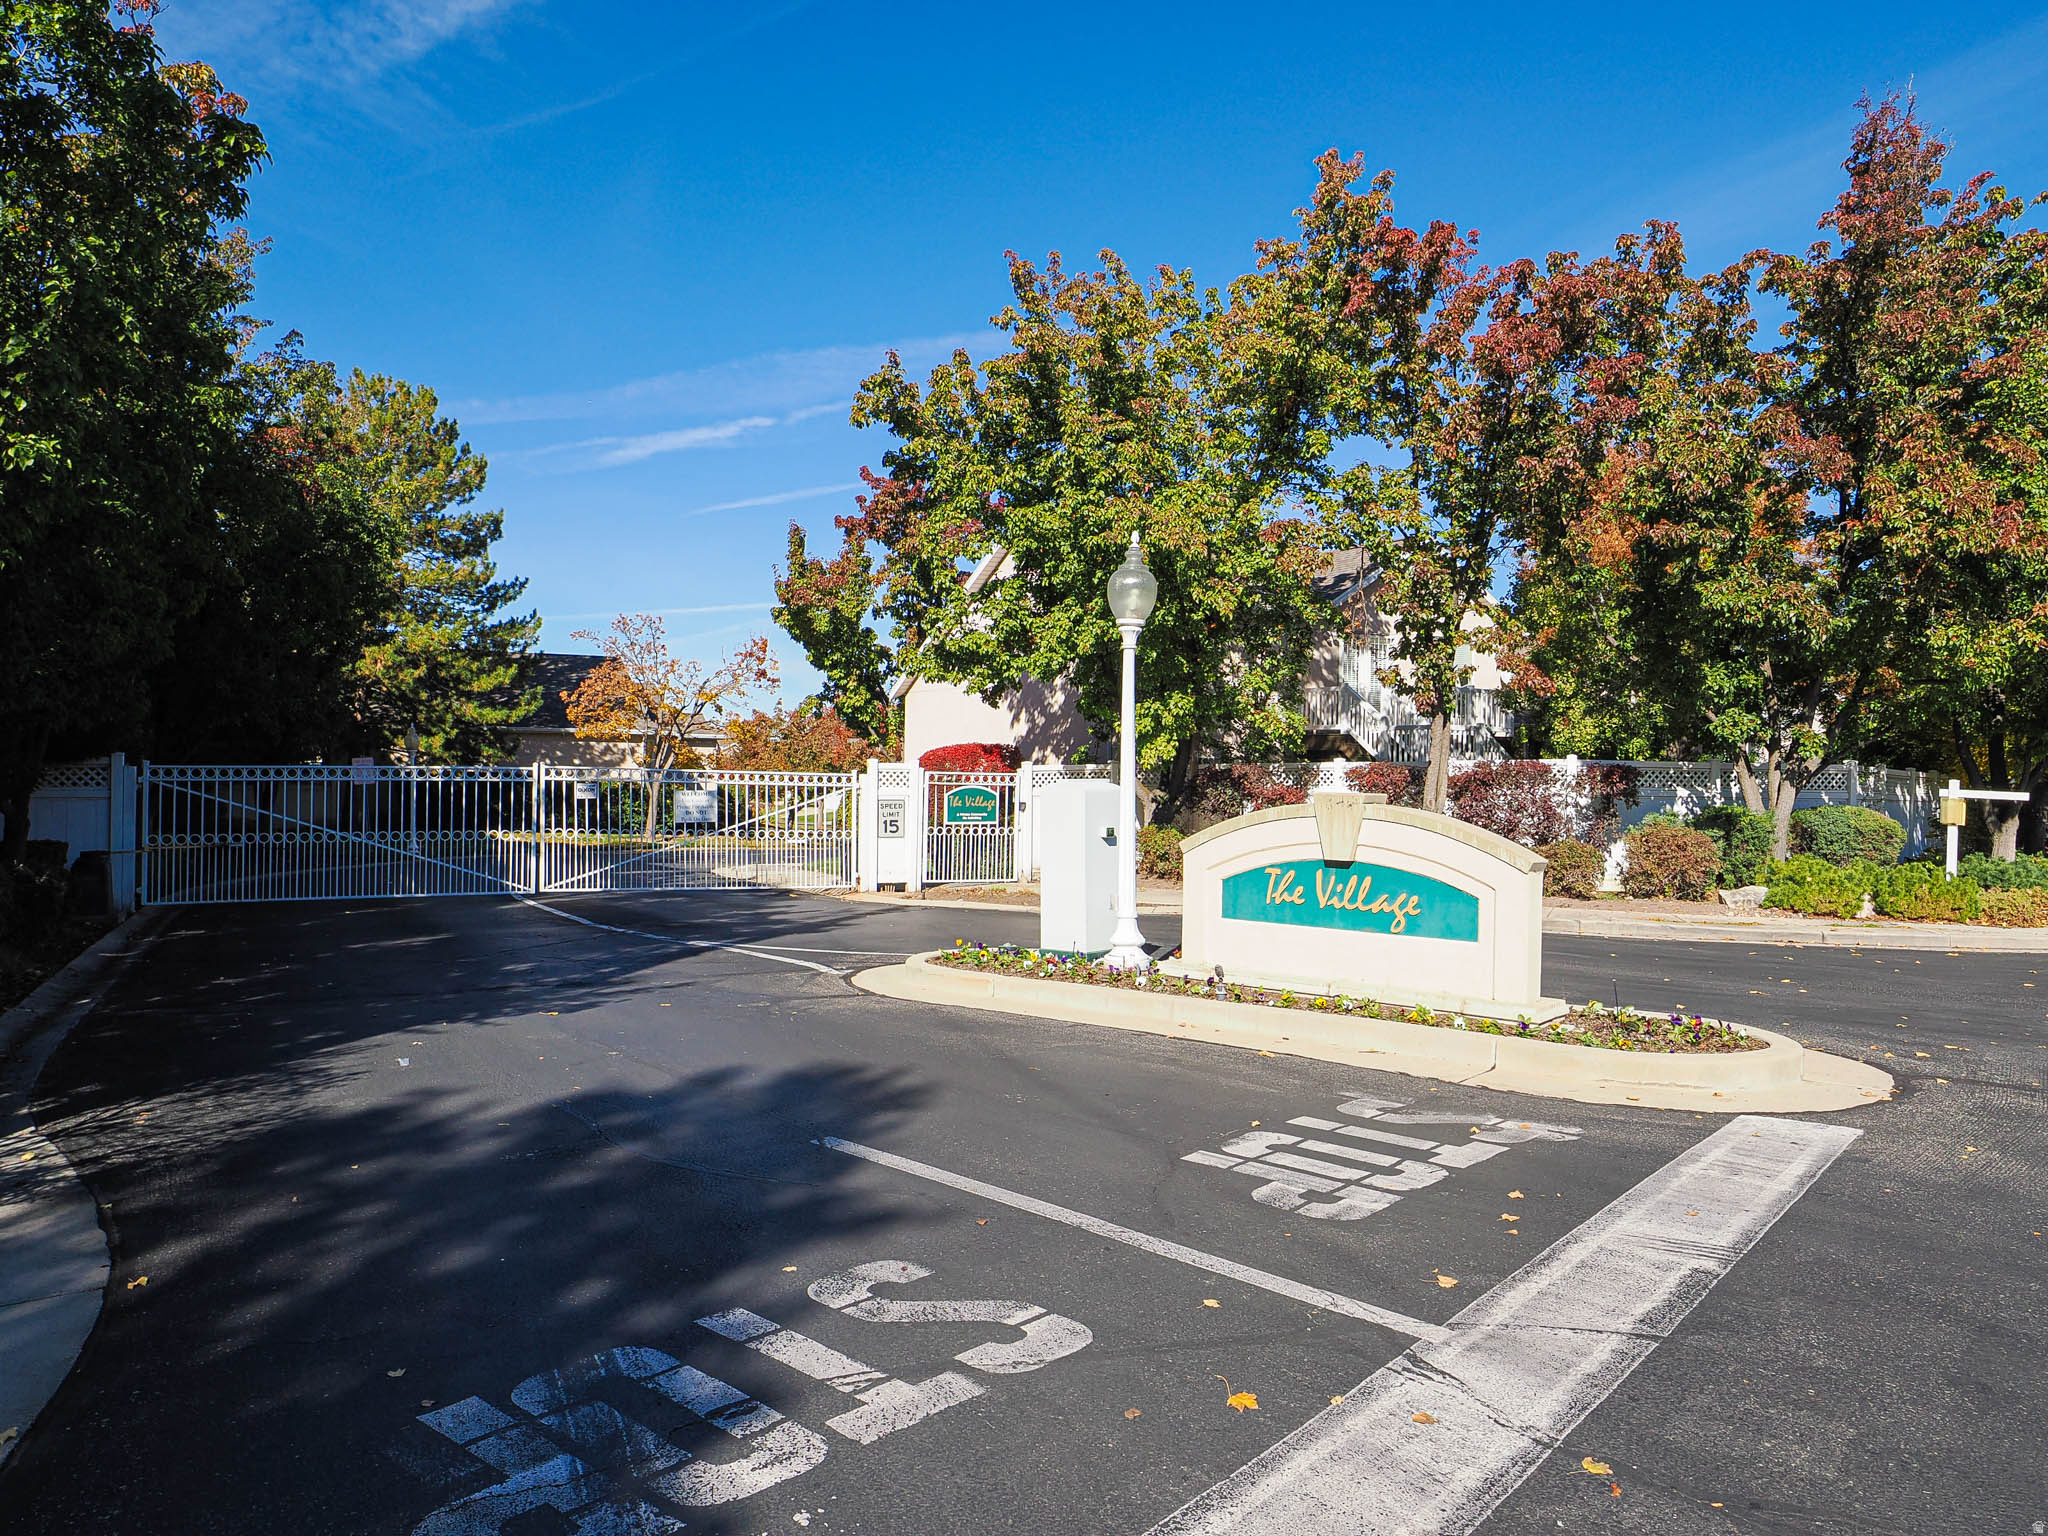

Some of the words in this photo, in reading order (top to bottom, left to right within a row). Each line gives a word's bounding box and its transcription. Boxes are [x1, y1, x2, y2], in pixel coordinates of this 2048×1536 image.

[949, 795, 962, 807] The
[965, 795, 995, 812] Village
[883, 819, 899, 834] 15
[1264, 867, 1306, 905] The
[1315, 868, 1422, 934] Village
[1180, 1097, 1583, 1221] STOP
